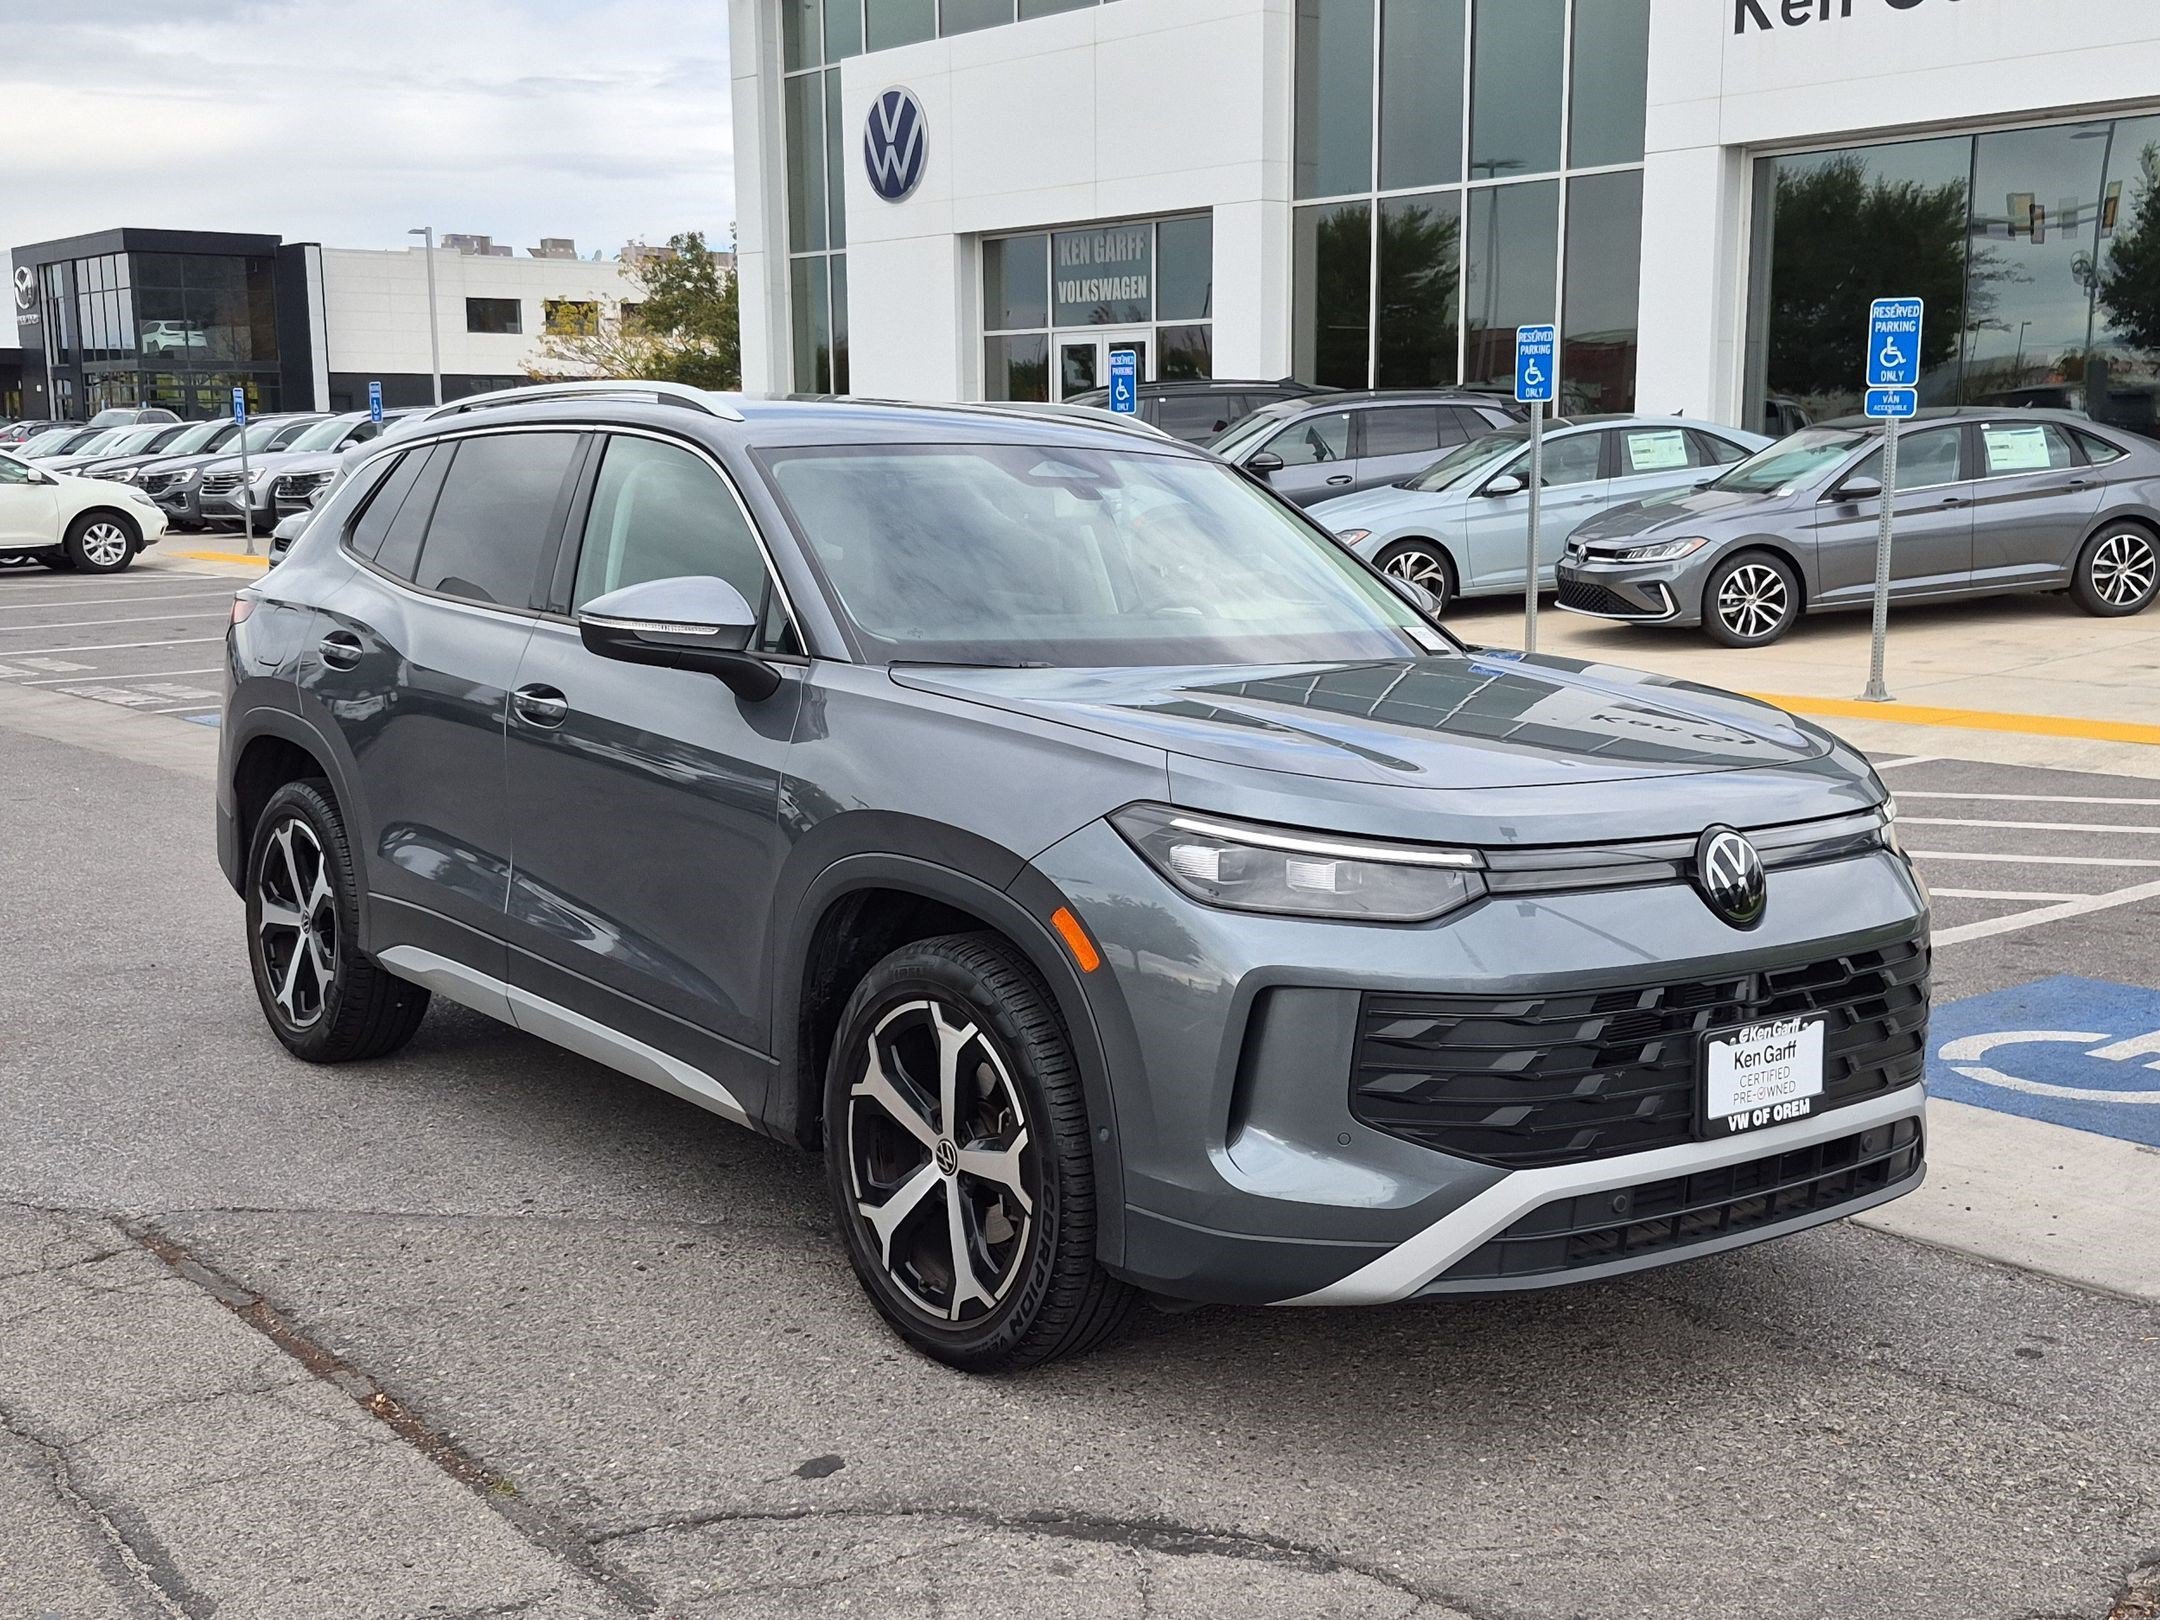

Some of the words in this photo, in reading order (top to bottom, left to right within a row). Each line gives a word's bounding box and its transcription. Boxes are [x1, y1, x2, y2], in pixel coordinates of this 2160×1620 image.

[1061, 236, 1090, 266] KEN
[1094, 231, 1145, 264] GARFF
[1058, 275, 1147, 304] VOLKSWAGEN
[1873, 305, 1920, 319] RESERVED
[1874, 320, 1916, 333] PARKING
[1518, 331, 1553, 343] RESERVED
[1520, 344, 1551, 355] PARKING
[1880, 370, 1905, 382] ONLY
[1525, 387, 1544, 398] ONLY
[1882, 395, 1900, 404] VAN
[1734, 1049, 1761, 1070] Ken
[1763, 1040, 1797, 1064] Garff
[1740, 1066, 1791, 1088] CERTIFIED
[1733, 1080, 1797, 1105] PRE-OWNED
[1728, 1111, 1750, 1131] VW
[1752, 1107, 1771, 1126] OF
[1773, 1098, 1811, 1121] OREM
